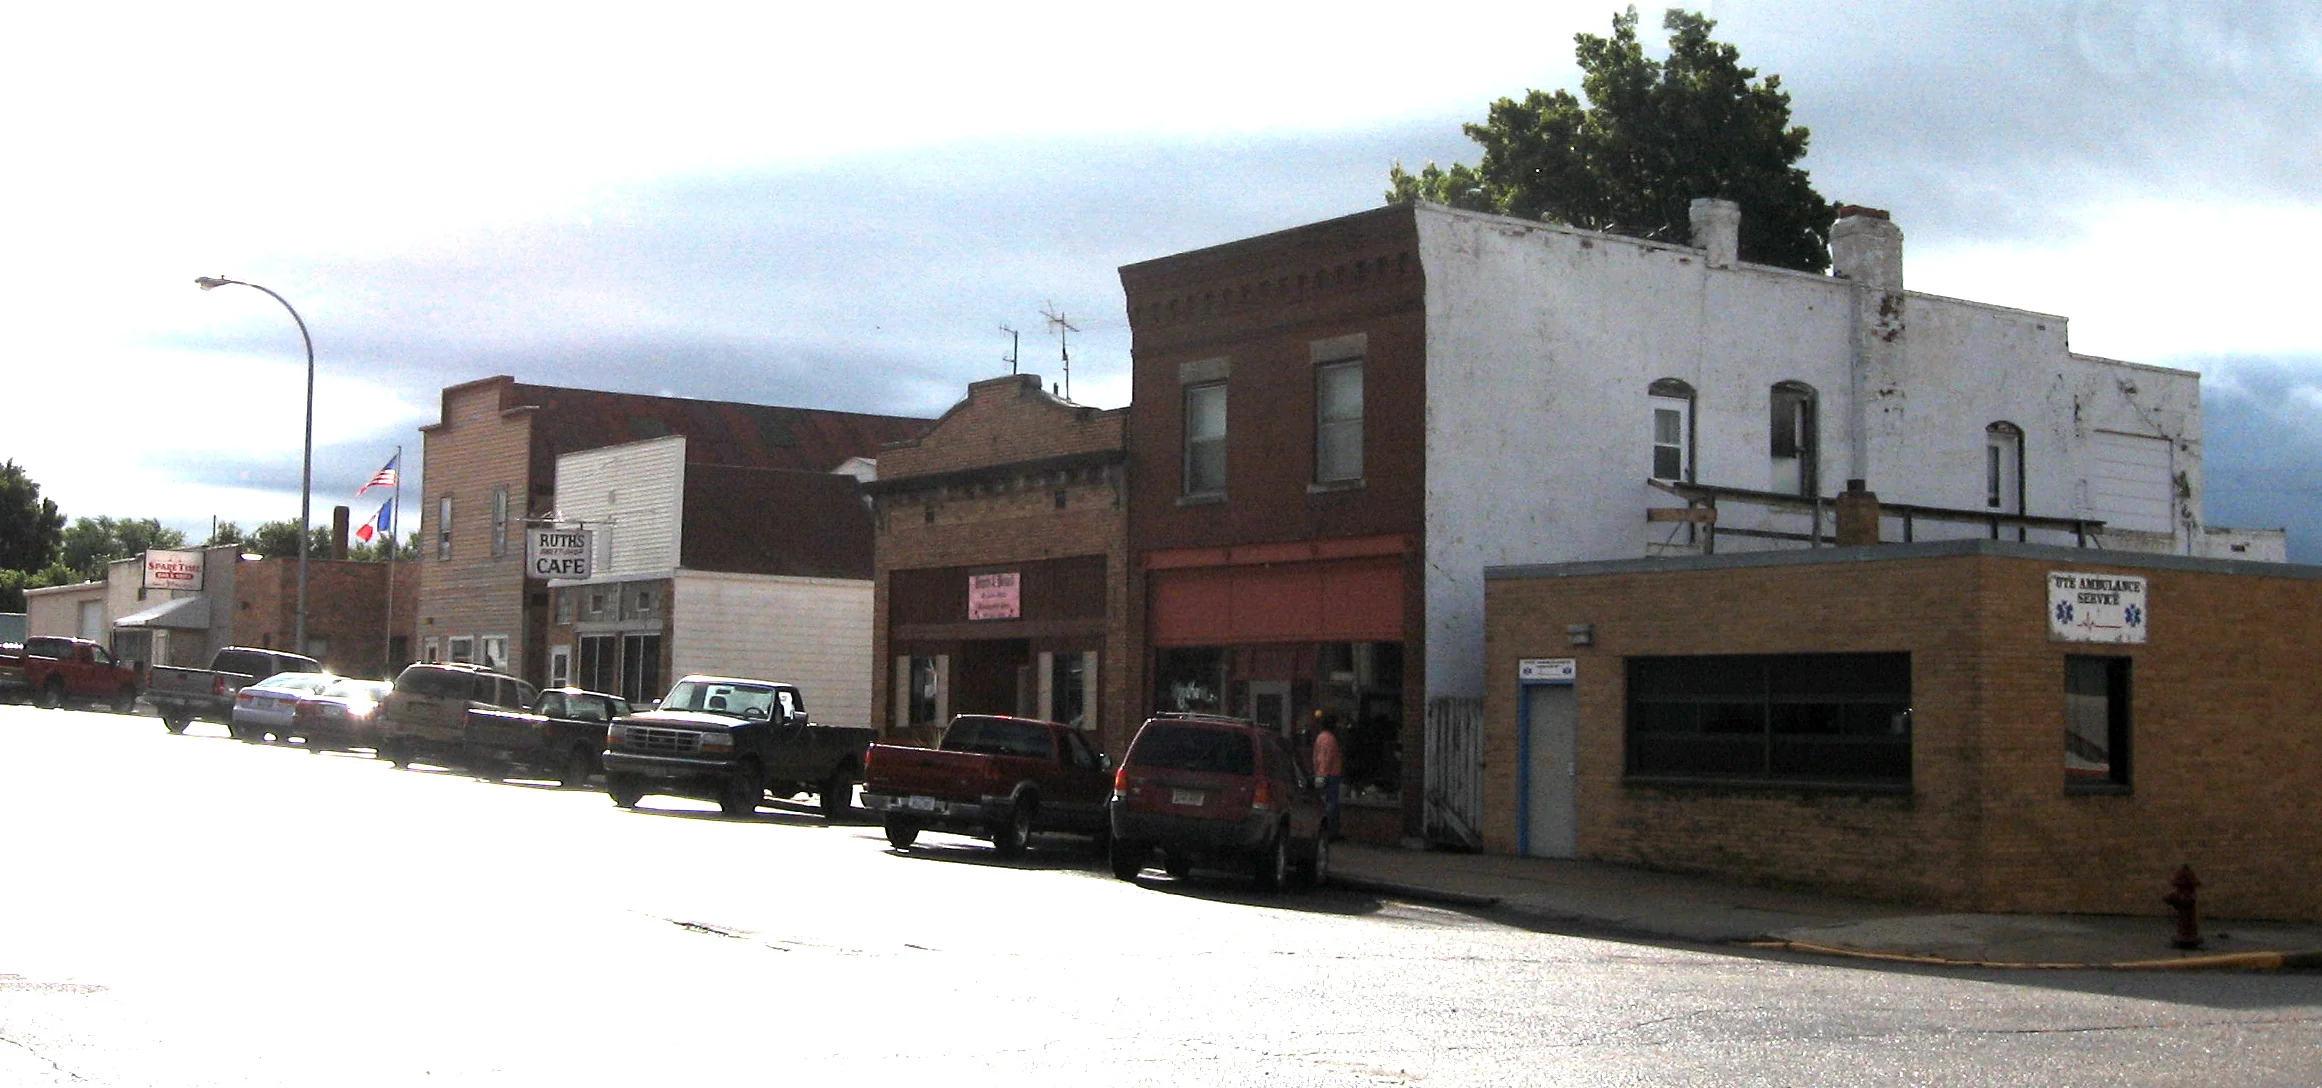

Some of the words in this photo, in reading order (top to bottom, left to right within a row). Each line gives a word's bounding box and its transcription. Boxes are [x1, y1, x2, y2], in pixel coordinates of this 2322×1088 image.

[148, 561, 177, 572] SPARE
[536, 558, 585, 574] CAFE
[2055, 576, 2077, 589] UTE
[2078, 578, 2141, 593] AMBULANCE
[2077, 592, 2120, 605] SERVICE
